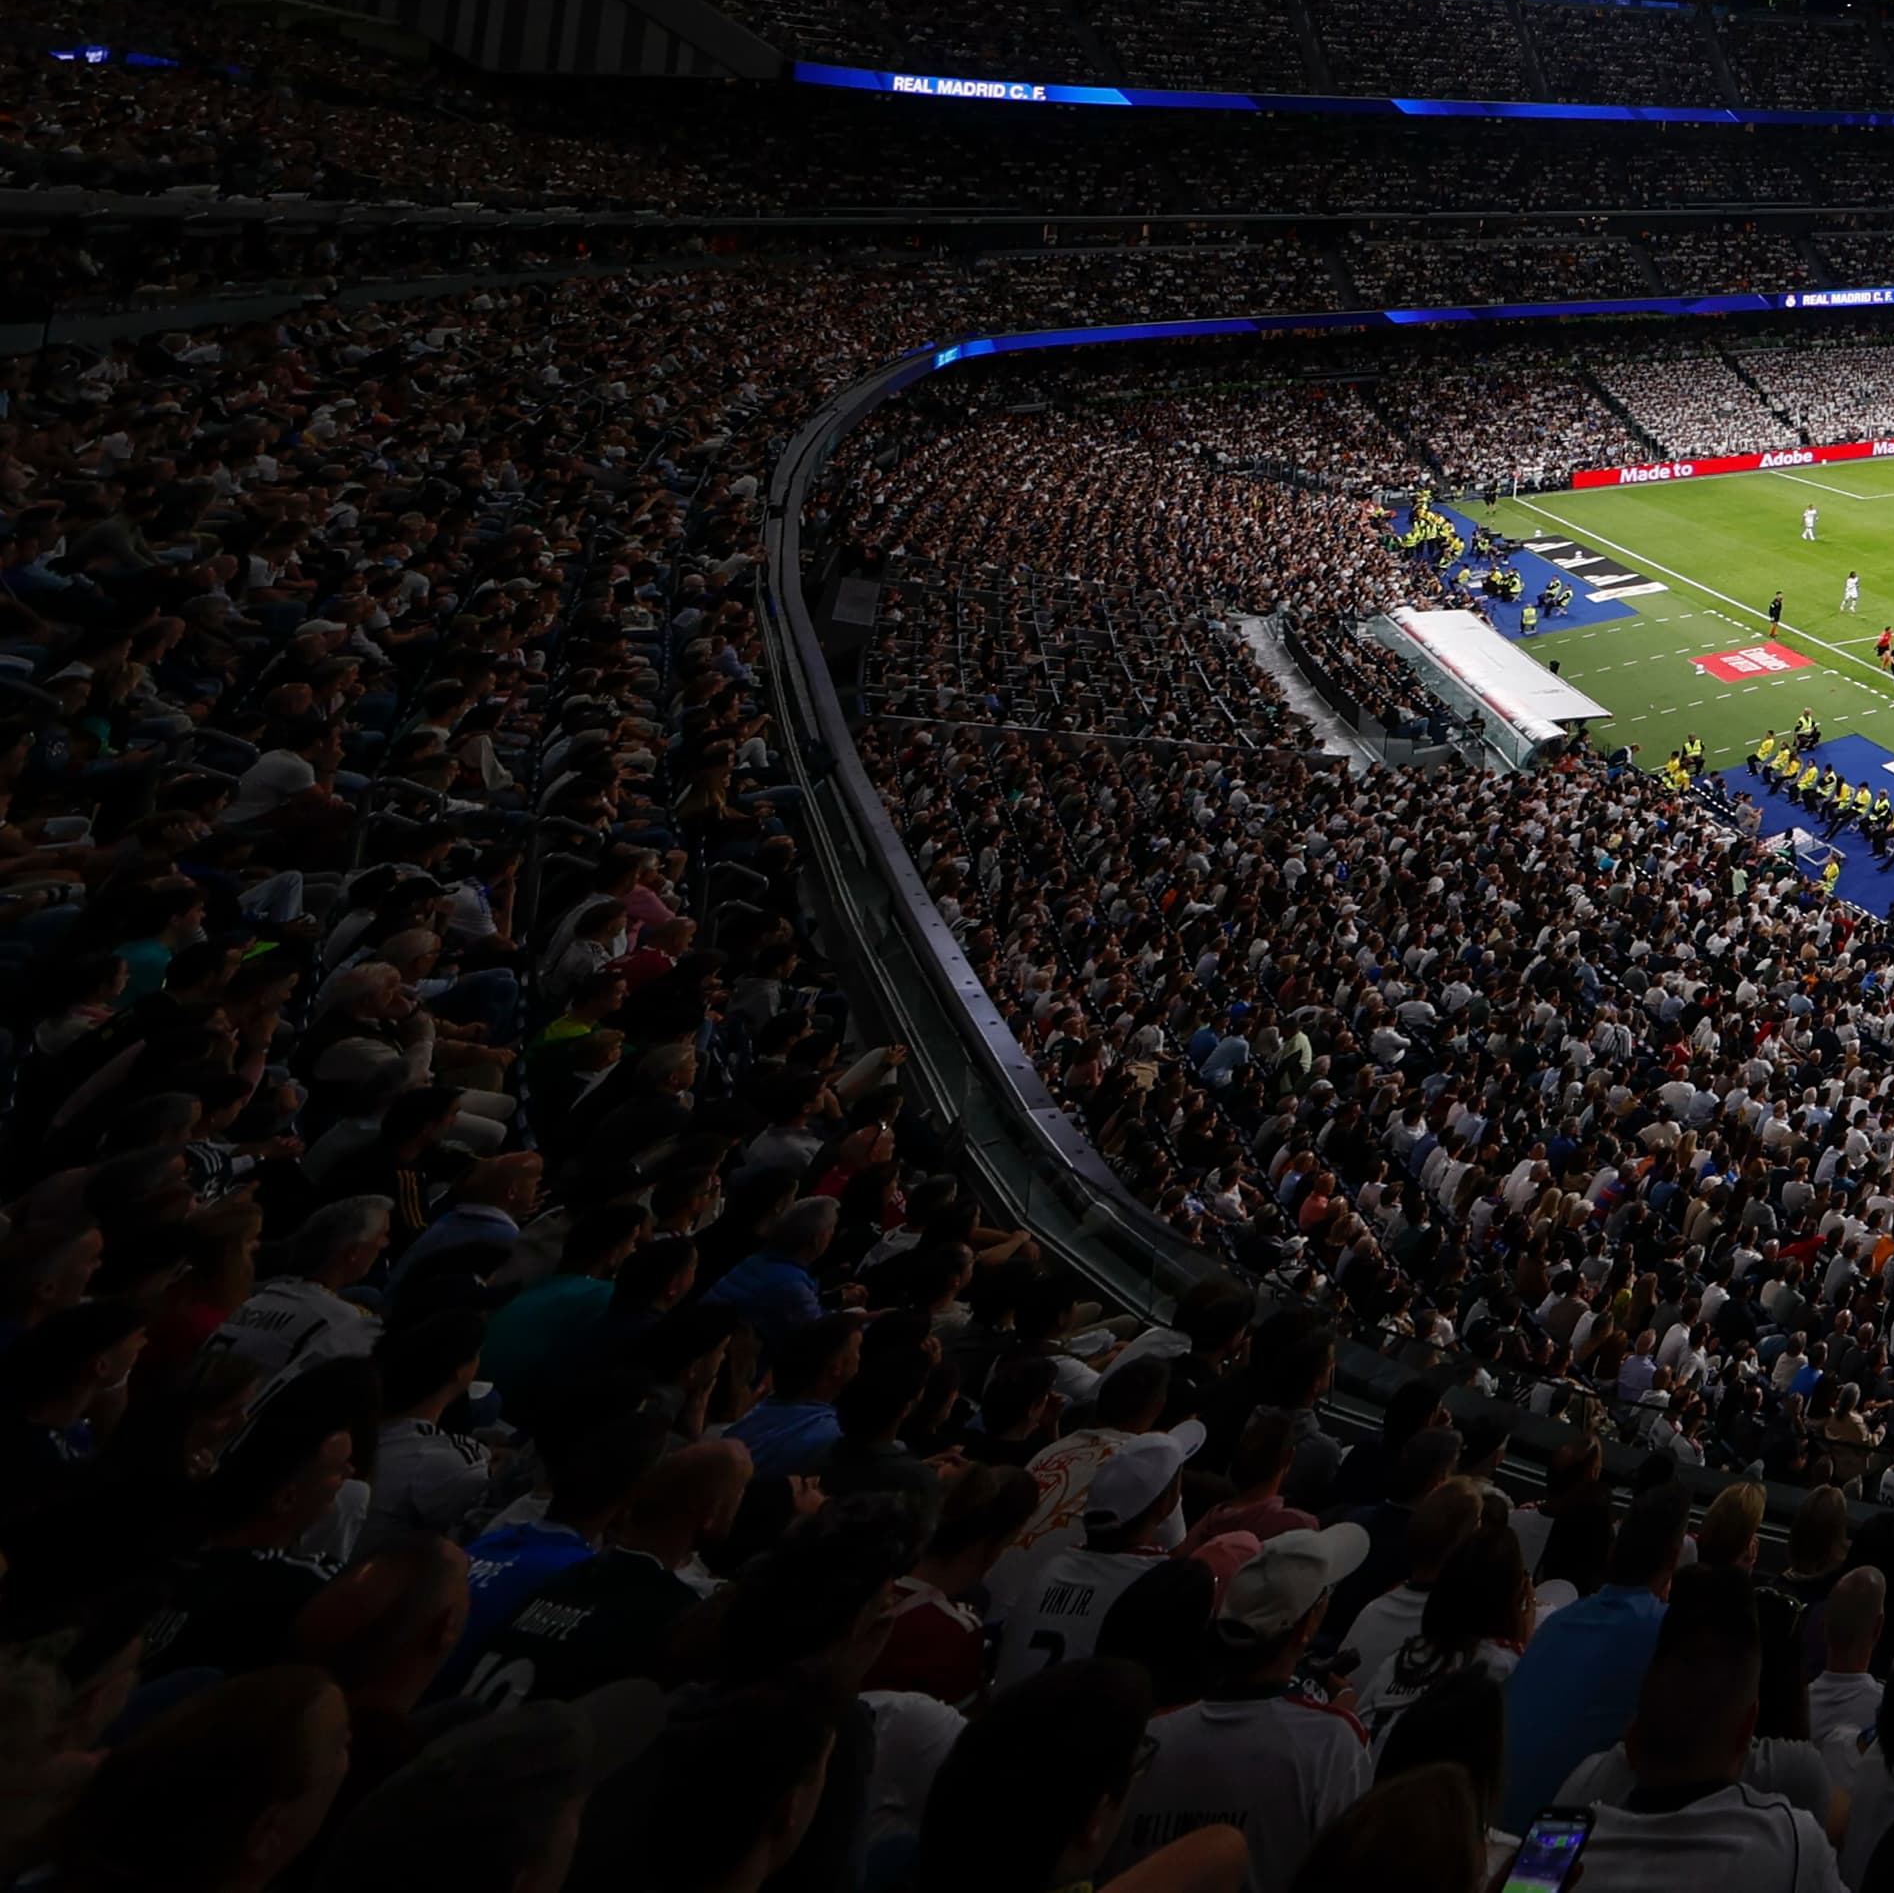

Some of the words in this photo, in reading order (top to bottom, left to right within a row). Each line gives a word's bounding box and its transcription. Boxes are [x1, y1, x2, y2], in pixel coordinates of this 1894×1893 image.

[893, 76, 932, 94] REAL
[937, 79, 1005, 98] MADRID
[1802, 294, 1829, 305] REAL
[1831, 292, 1871, 304] MADRID
[1760, 449, 1813, 467] Adobe
[1620, 465, 1669, 484] Made
[1673, 462, 1692, 477] to
[1040, 1586, 1074, 1615] VINI
